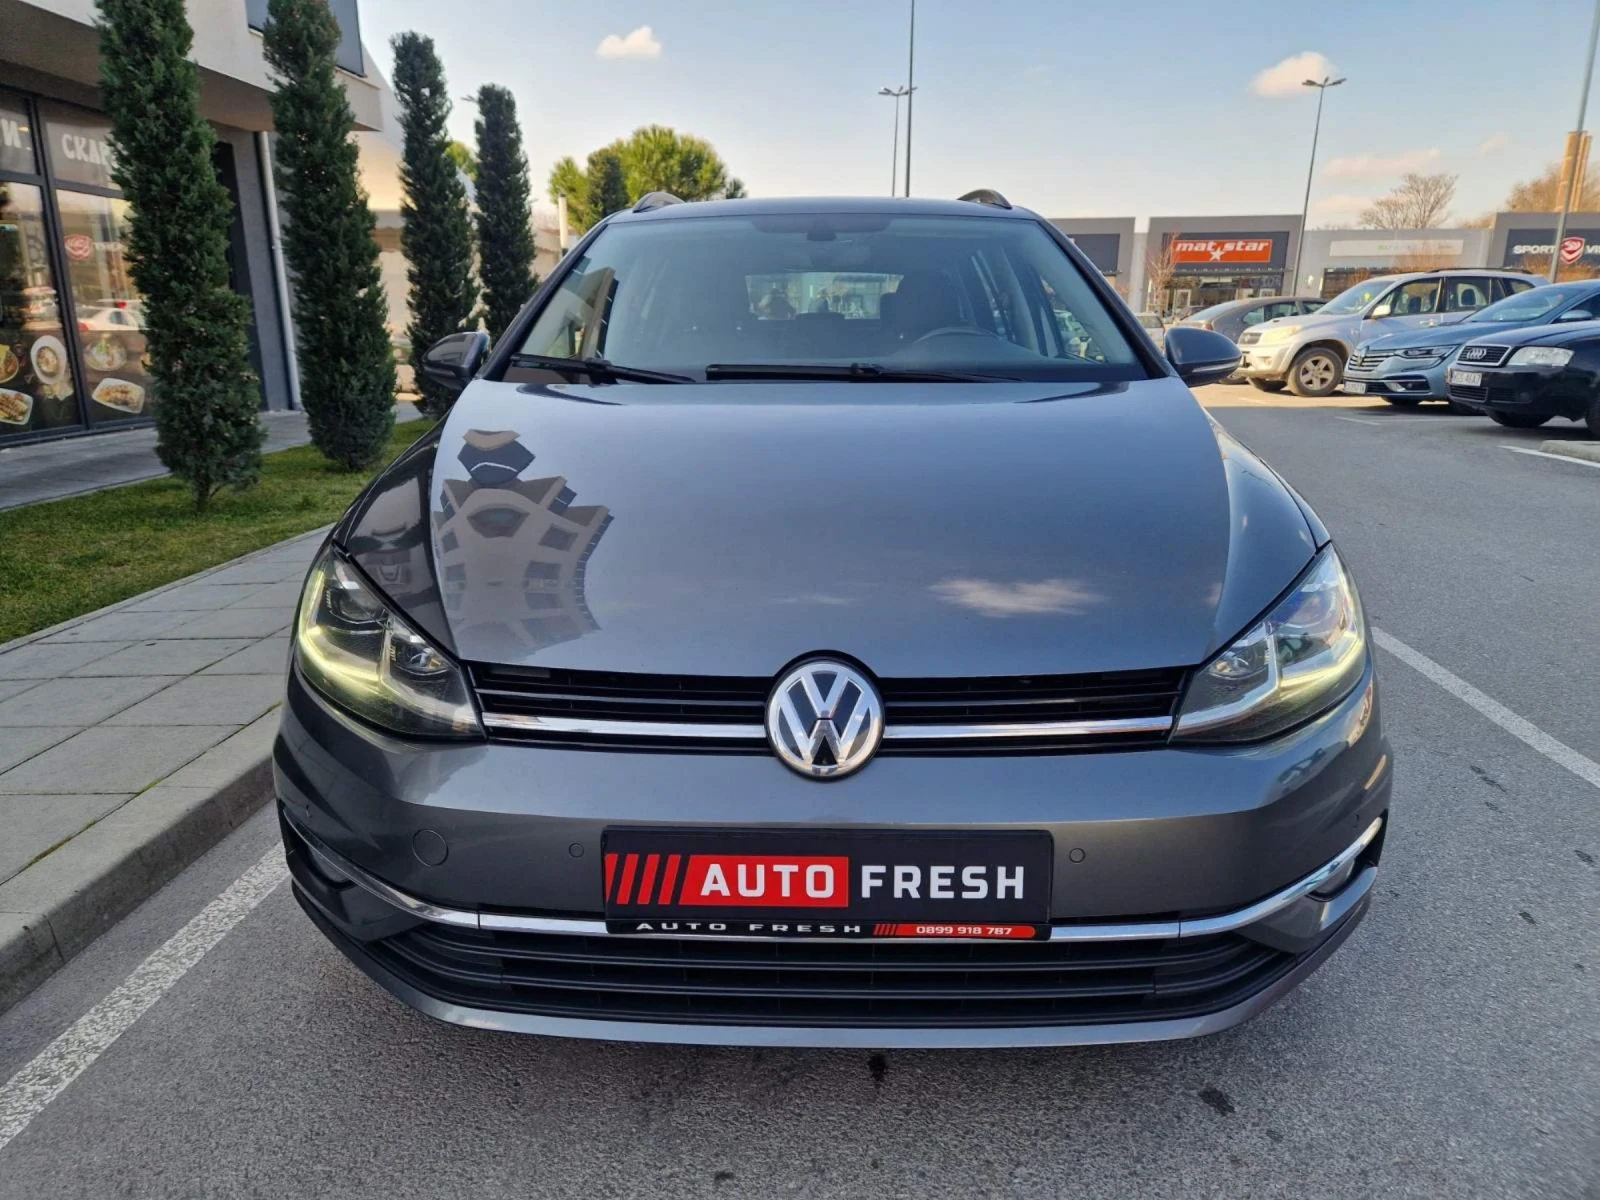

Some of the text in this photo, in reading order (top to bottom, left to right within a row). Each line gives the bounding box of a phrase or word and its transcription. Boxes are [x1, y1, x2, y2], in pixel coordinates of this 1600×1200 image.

[1175, 240, 1270, 252] mat star
[1513, 245, 1557, 254] SPORT
[700, 863, 1025, 900] AUTO FRESH
[636, 922, 1013, 936] AUTO FRESH 0899 918 787
